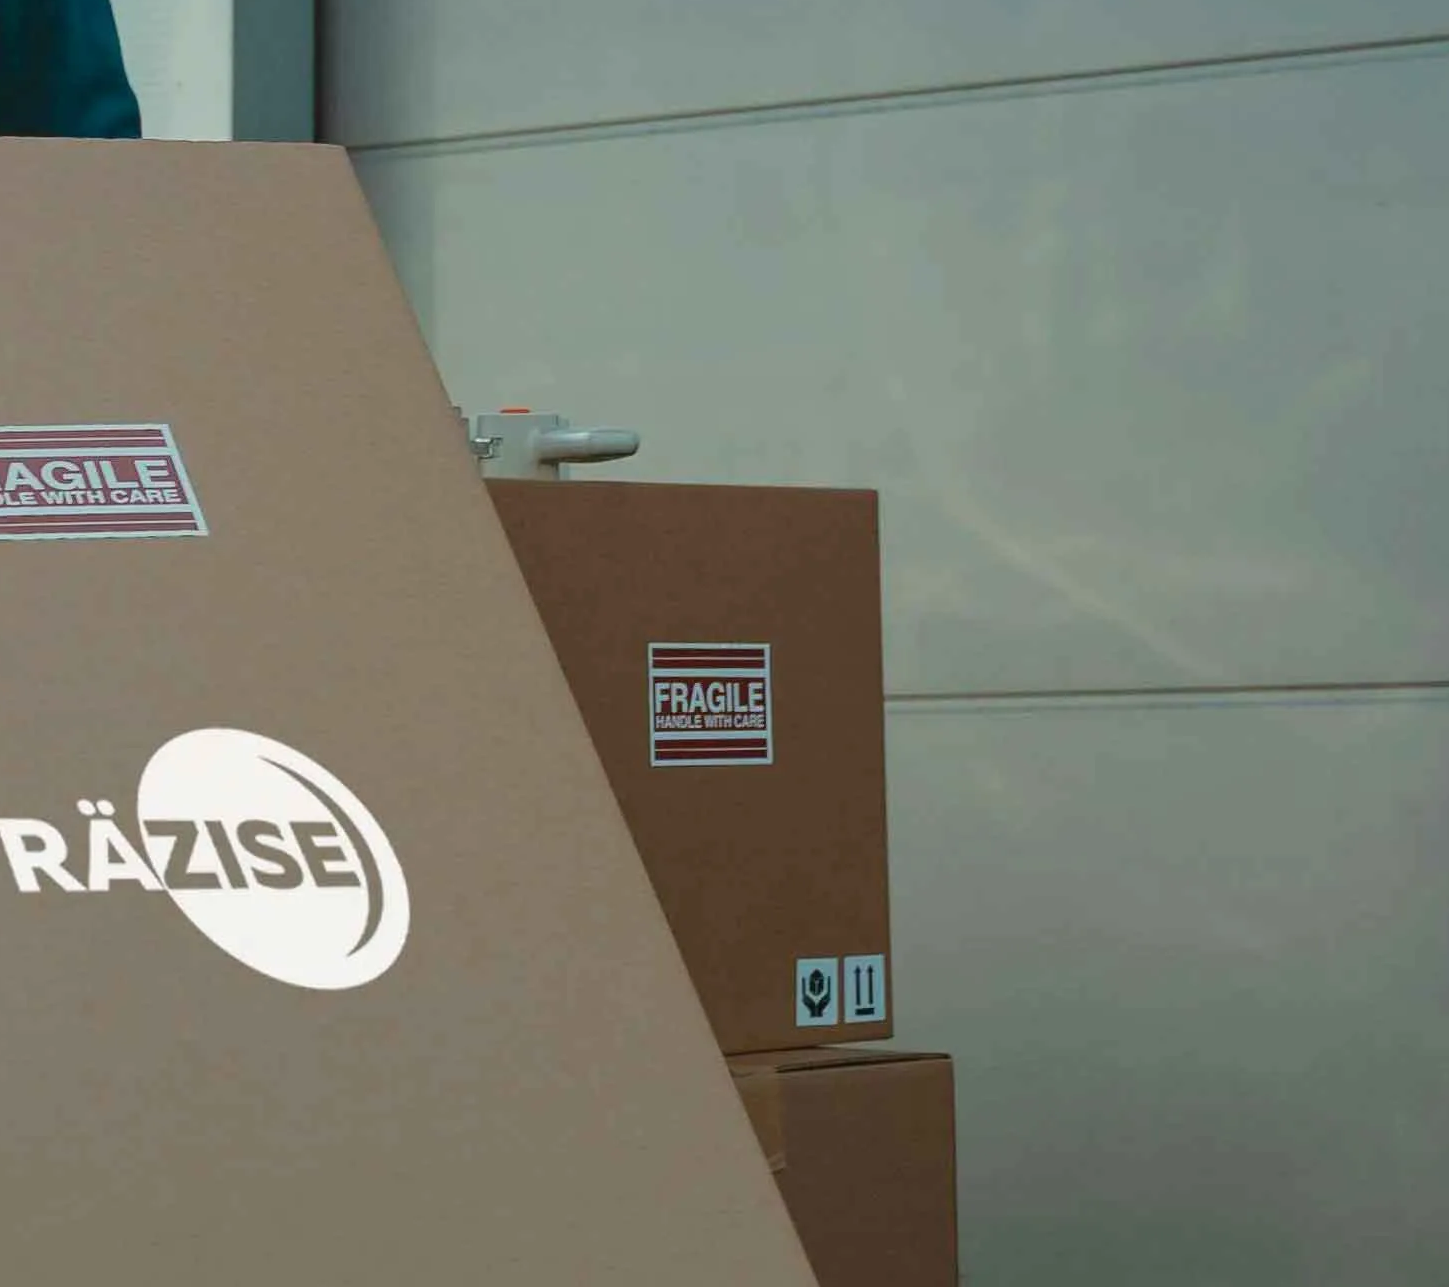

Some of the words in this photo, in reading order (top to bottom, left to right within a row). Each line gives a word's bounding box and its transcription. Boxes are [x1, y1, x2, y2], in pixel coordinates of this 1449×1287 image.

[42, 490, 105, 506] WITH
[111, 488, 182, 505] CARE
[654, 682, 765, 713] FRAGILE
[655, 715, 703, 729] HANDLE
[704, 715, 733, 728] WITH
[734, 714, 765, 728] CARE
